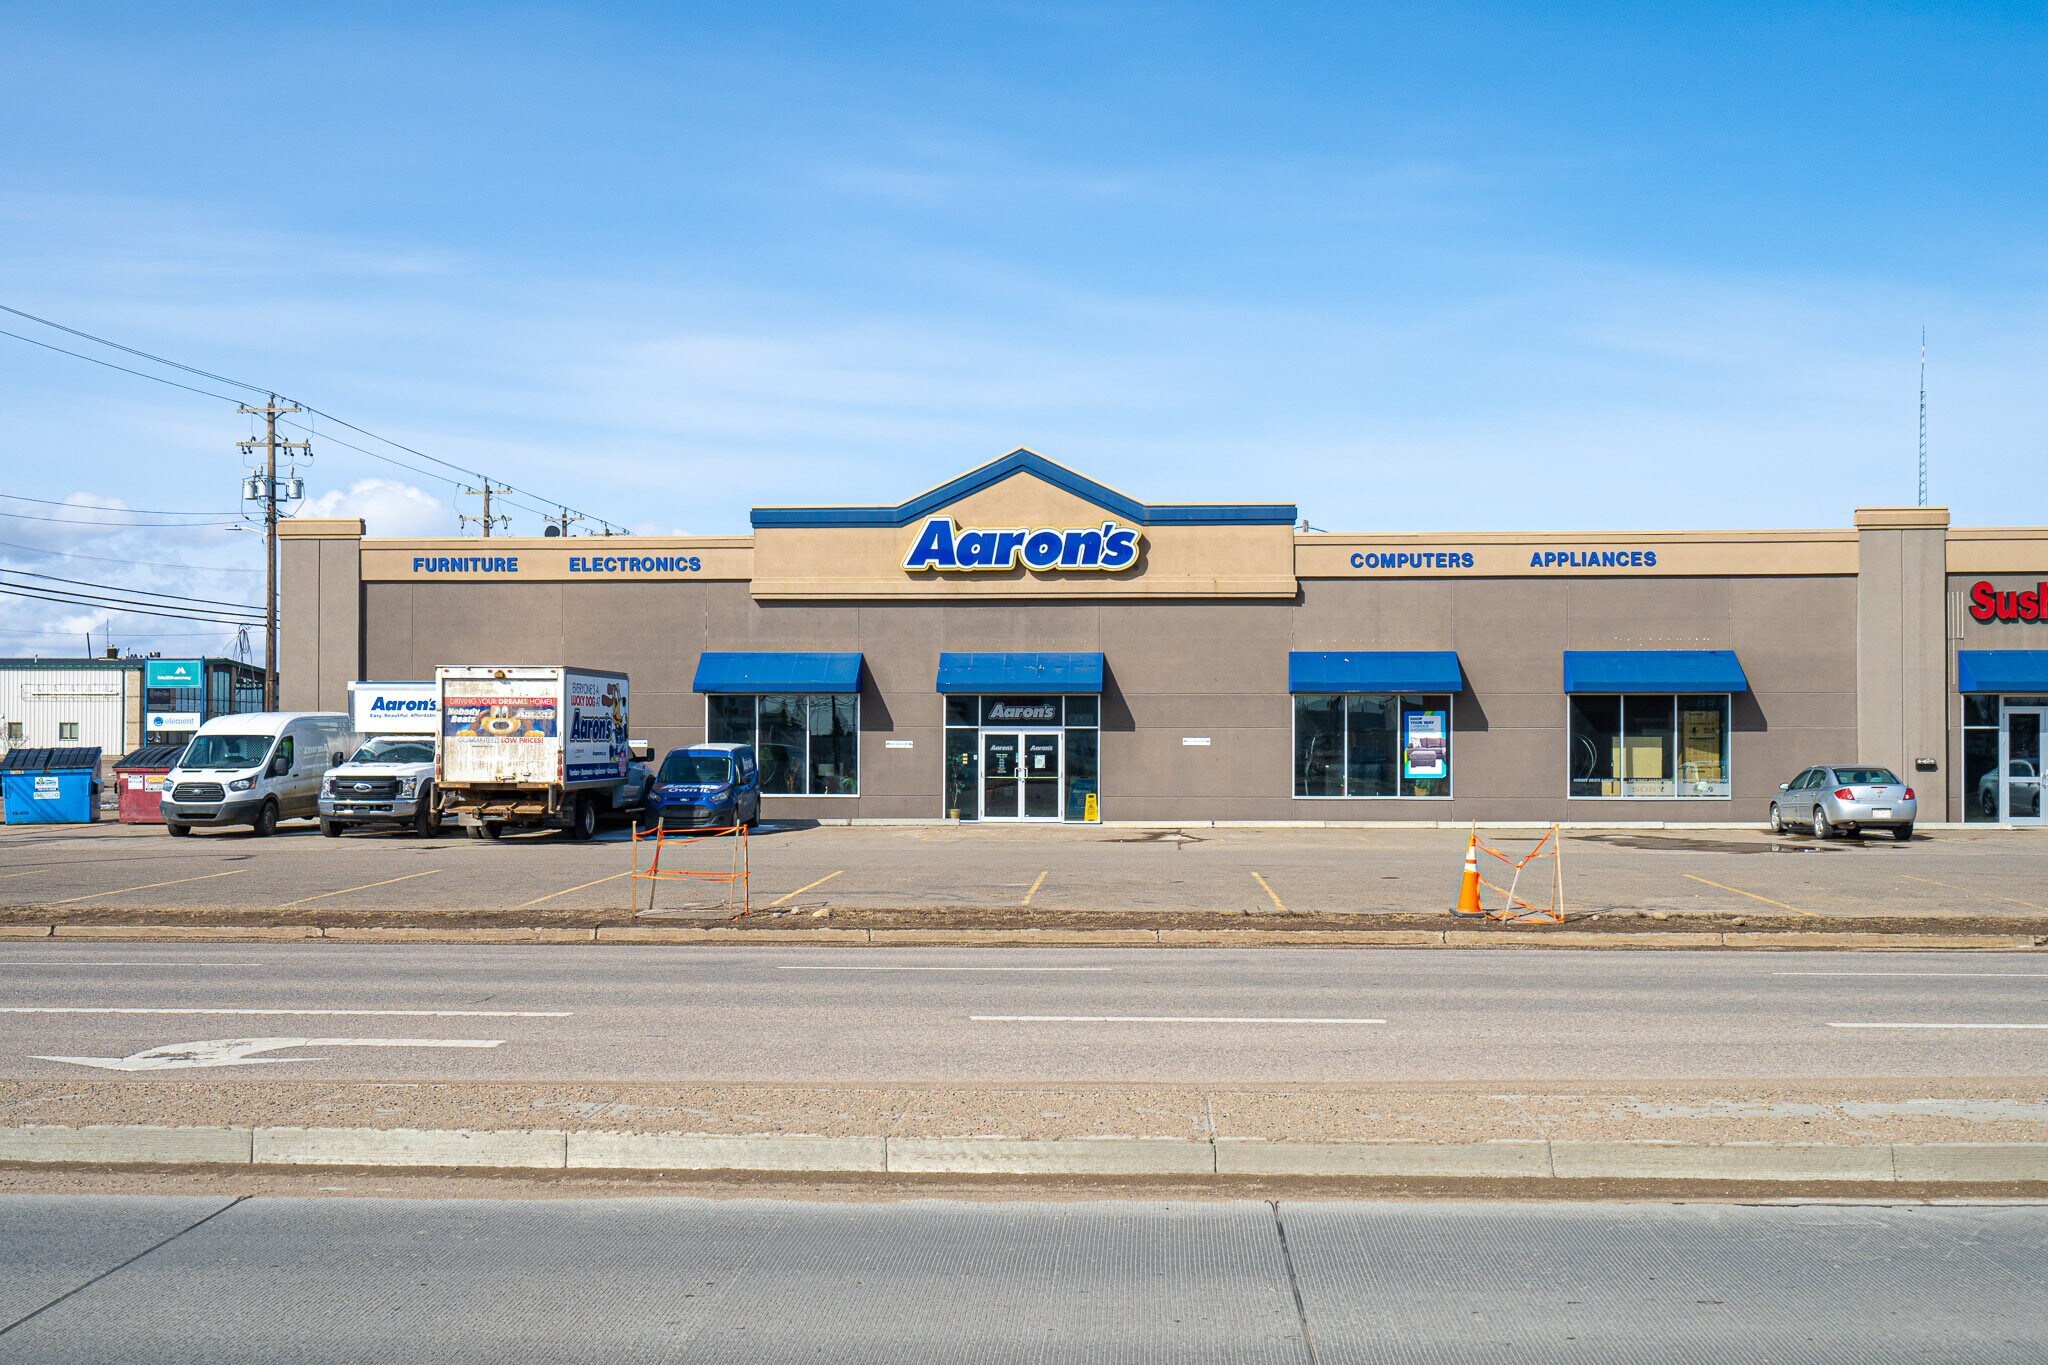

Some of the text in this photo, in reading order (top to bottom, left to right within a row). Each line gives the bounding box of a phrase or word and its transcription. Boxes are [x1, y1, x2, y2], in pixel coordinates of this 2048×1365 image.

[903, 516, 1140, 569] Aaron's
[412, 557, 518, 572] FURNITURE
[569, 556, 701, 572] ELECTRONICS
[1350, 552, 1474, 568] COMPUTERS
[1530, 551, 1657, 567] APPLIANCES
[370, 696, 436, 711] Aaron's
[570, 694, 585, 706] LUCKY
[585, 696, 596, 707] DOG
[447, 707, 481, 716] Nobody
[989, 702, 1056, 719] Aaron's
[451, 715, 477, 723] Beats
[570, 708, 612, 743] Aaron's
